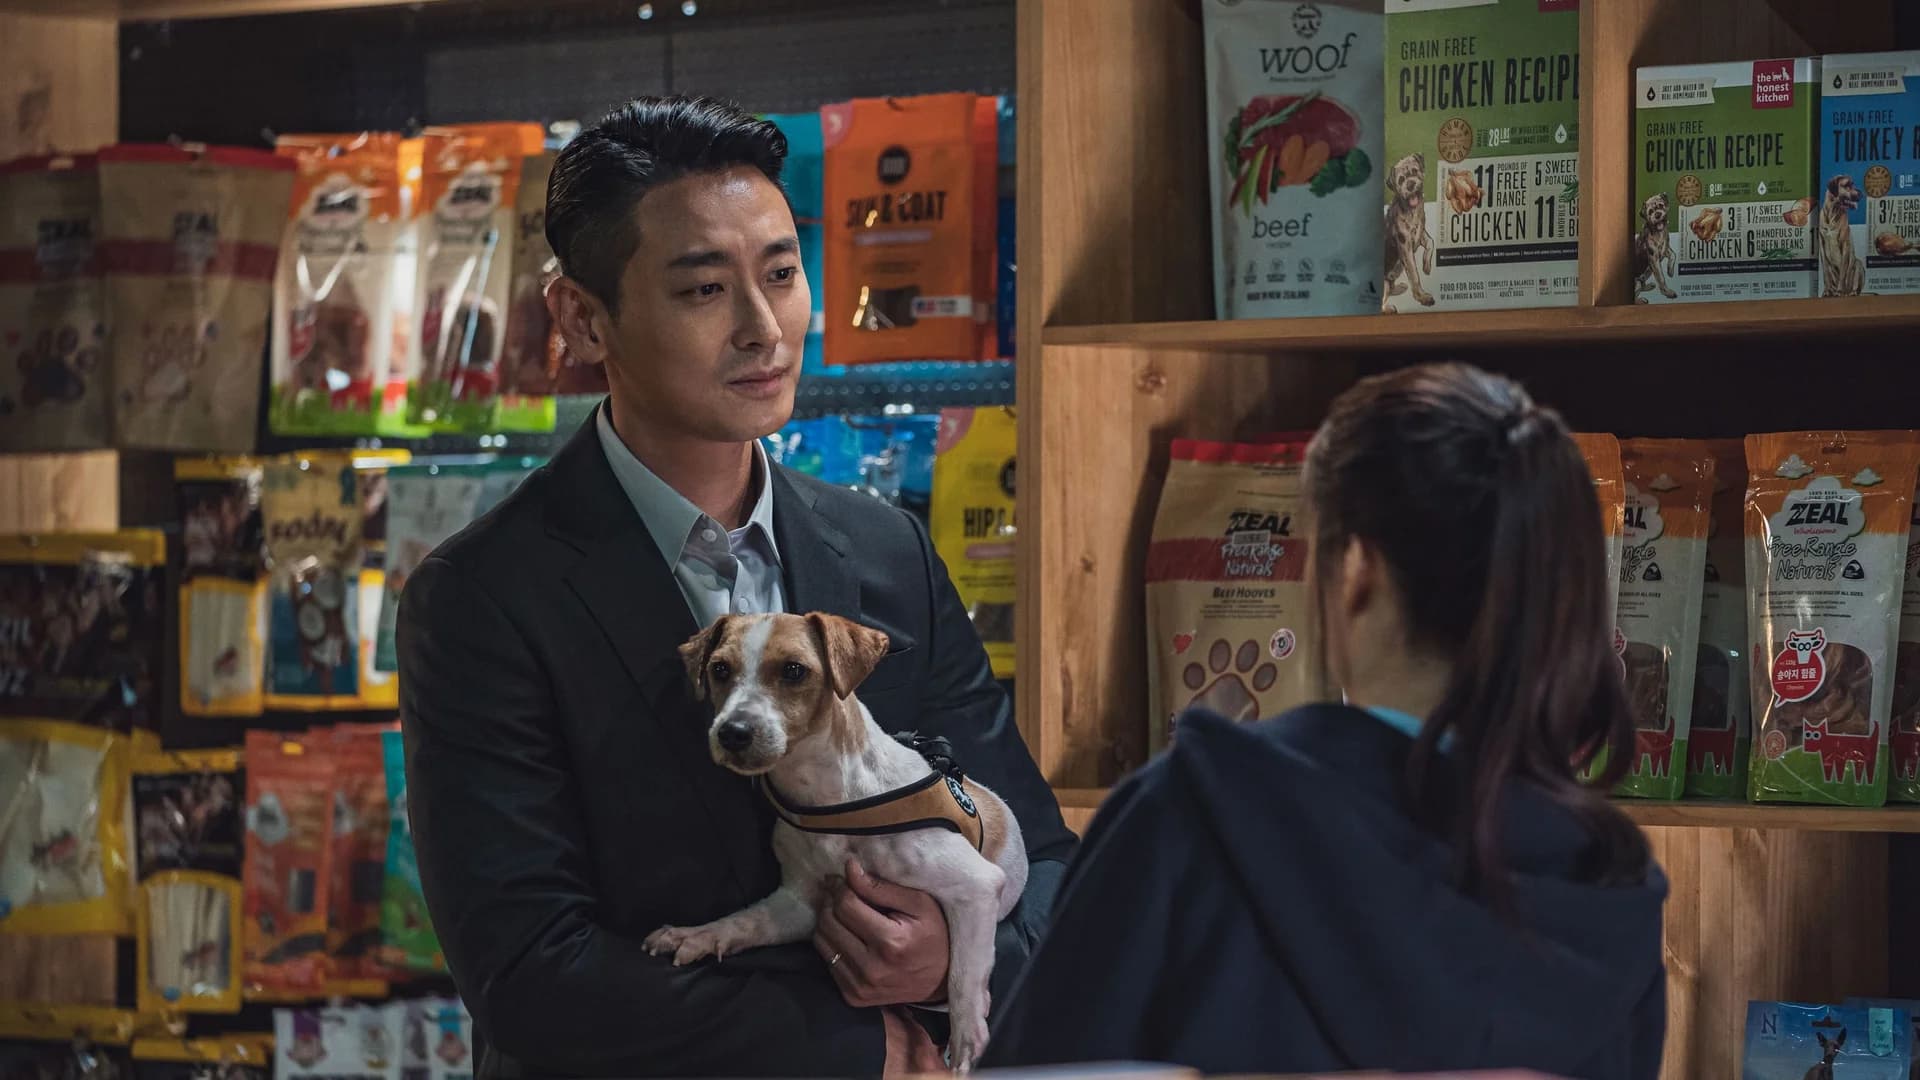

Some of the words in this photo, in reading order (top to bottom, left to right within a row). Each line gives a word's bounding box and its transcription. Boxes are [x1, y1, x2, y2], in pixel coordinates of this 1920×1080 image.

[1257, 32, 1359, 74] woof
[1400, 41, 1440, 61] GRAIN
[1444, 36, 1477, 57] FREE
[1400, 59, 1495, 113] CHICKEN
[1756, 72, 1771, 83] the
[1756, 83, 1790, 93] honest
[1756, 93, 1790, 103] kitchen
[1646, 121, 1676, 137] GRAIN
[1680, 120, 1704, 135] FREE
[1832, 111, 1864, 126] GRAIN
[1868, 109, 1895, 124] FREE
[1488, 128, 1500, 148] 28
[1832, 126, 1905, 163] TURKEY
[1645, 136, 1717, 173] CHICKEN
[1724, 133, 1785, 168] RECIPE
[1520, 161, 1528, 170] OF
[1534, 161, 1543, 187] 5
[1545, 159, 1578, 174] SWEET
[1474, 163, 1495, 209] 11
[1496, 171, 1528, 191] FREE
[1544, 174, 1578, 185] POTATOES
[1496, 190, 1527, 207] RANGE
[1759, 204, 1783, 215] SWEET
[1251, 212, 1313, 239] beef
[1450, 209, 1527, 244] CHICKEN
[1534, 195, 1556, 239] 11
[1728, 206, 1736, 231] 3
[1746, 229, 1755, 258] 6
[1756, 228, 1793, 240] HANDFULS
[1795, 227, 1803, 237] OF
[1756, 239, 1779, 252] GREEN
[1780, 238, 1804, 250] BEANS
[1689, 238, 1742, 260] CHICKEN
[963, 506, 995, 538] HIP
[1224, 510, 1291, 537] ZEAL
[1623, 506, 1647, 530] AL
[1784, 502, 1849, 527] ZEAL
[1768, 536, 1802, 558] Free
[1802, 536, 1858, 564] Range
[1224, 560, 1274, 578] Naturals
[1775, 558, 1840, 582] Naturals
[1776, 668, 1799, 681] 송아지
[1801, 667, 1817, 680] 힘줄
